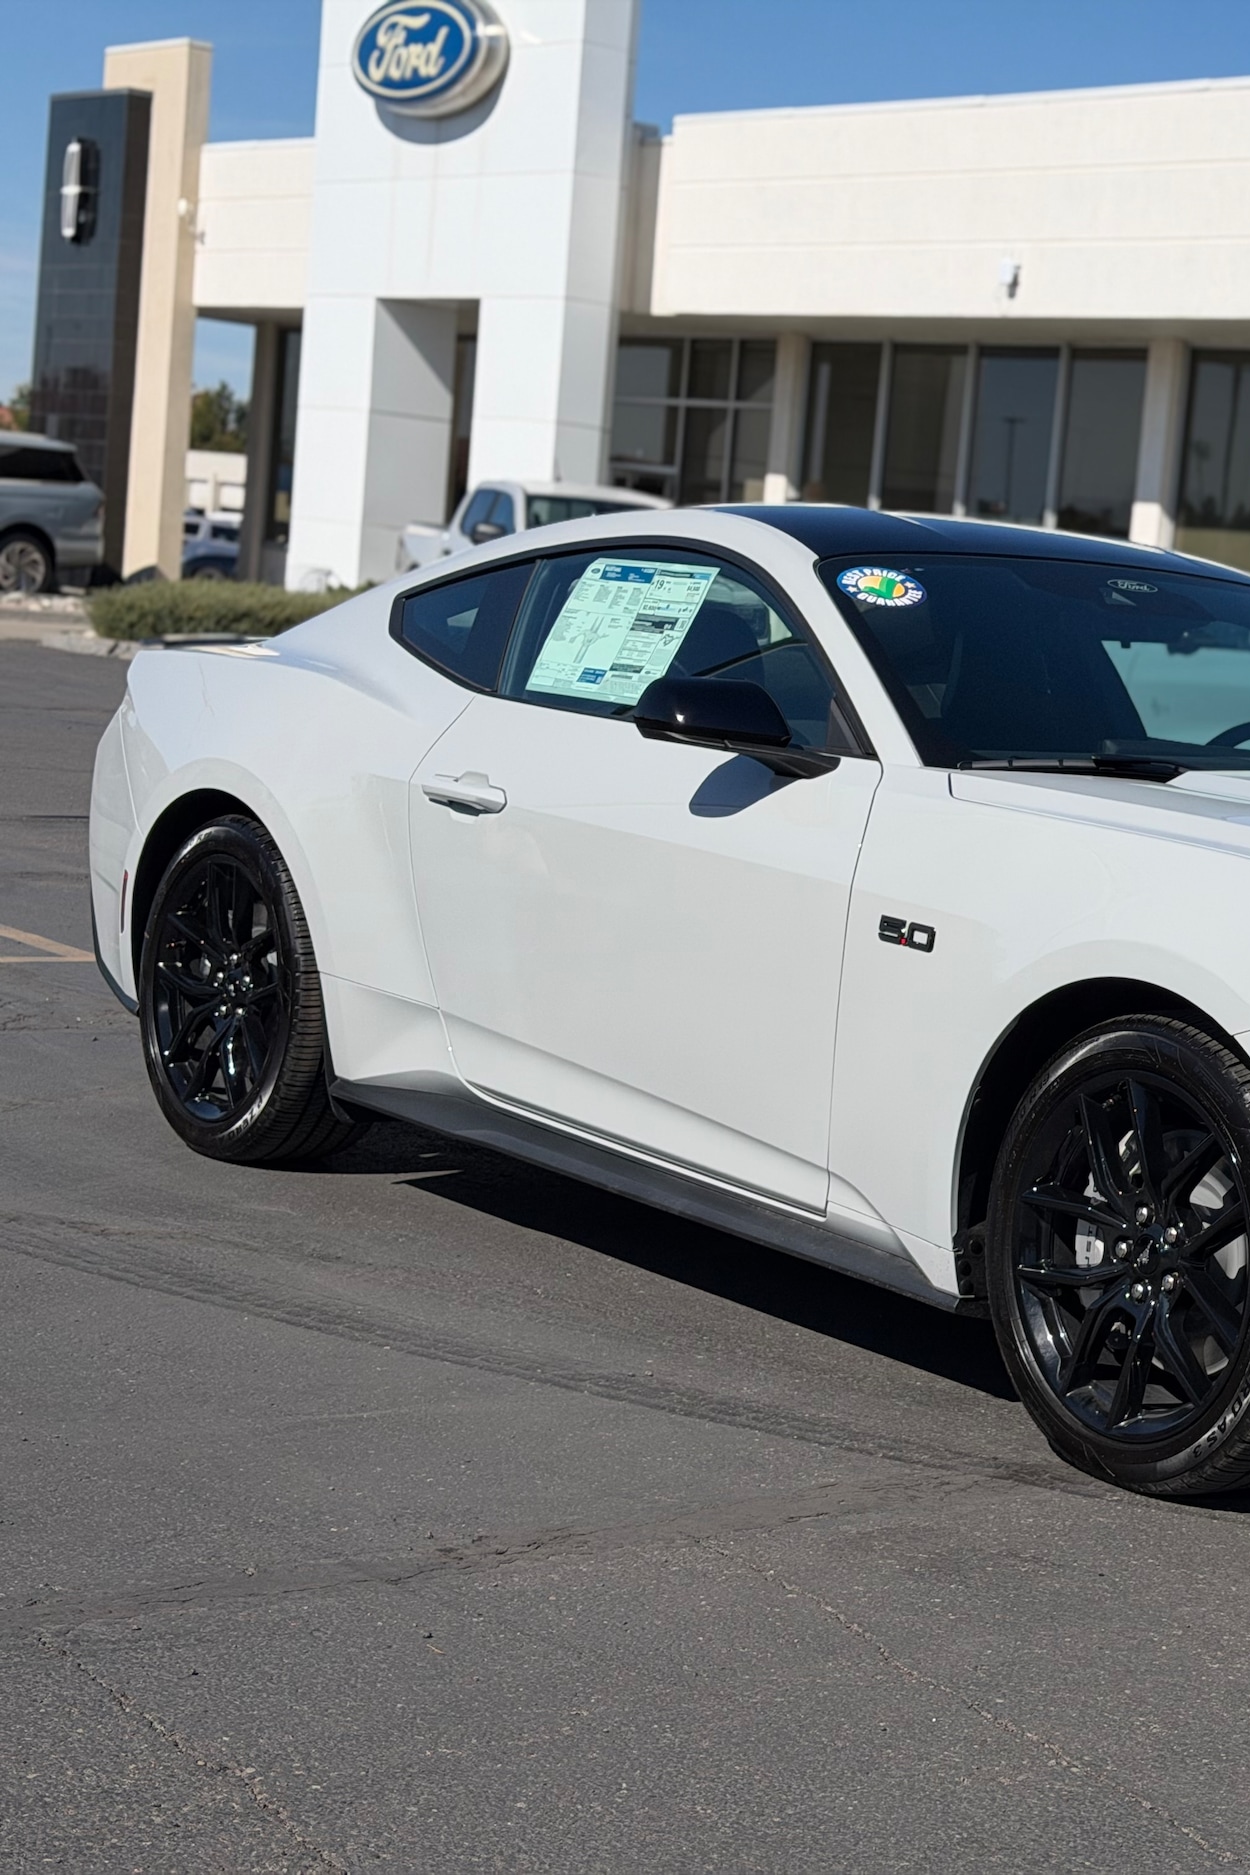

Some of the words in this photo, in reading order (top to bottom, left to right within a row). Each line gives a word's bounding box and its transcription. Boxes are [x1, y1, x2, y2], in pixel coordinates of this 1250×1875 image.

[367, 12, 451, 83] Ford
[862, 568, 907, 582] PRICE
[856, 588, 923, 607] GUARANTEE
[877, 914, 937, 953] 5.0
